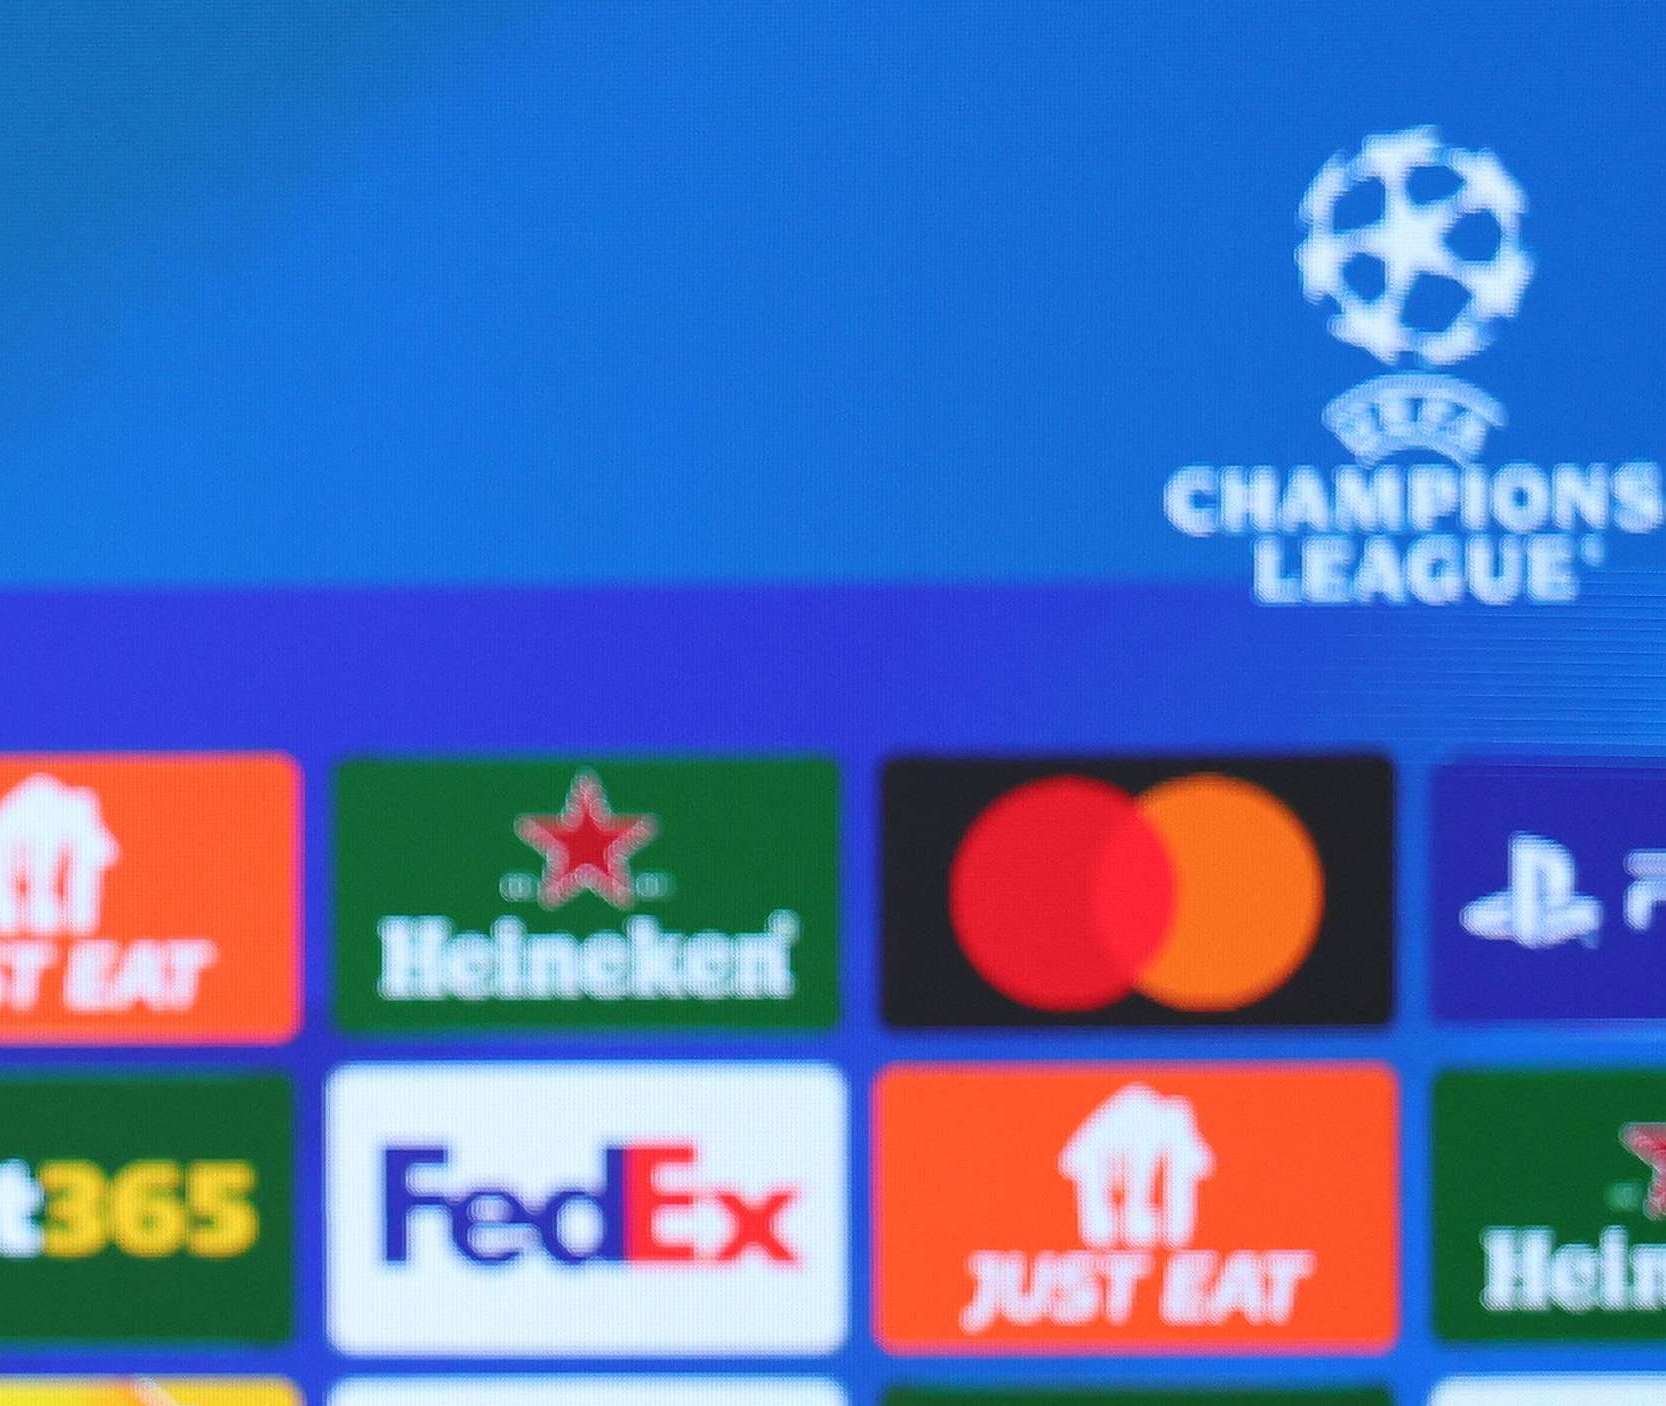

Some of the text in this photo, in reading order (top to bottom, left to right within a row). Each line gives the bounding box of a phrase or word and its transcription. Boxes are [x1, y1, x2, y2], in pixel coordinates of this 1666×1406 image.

[1163, 462, 1665, 537] CHAMPIONS
[1251, 533, 1580, 607] LEAGUE
[62, 938, 218, 1013] EAT
[377, 912, 799, 1001] Heineken
[382, 1142, 804, 1268] FedEx
[959, 1247, 1319, 1335] JUST EAT
